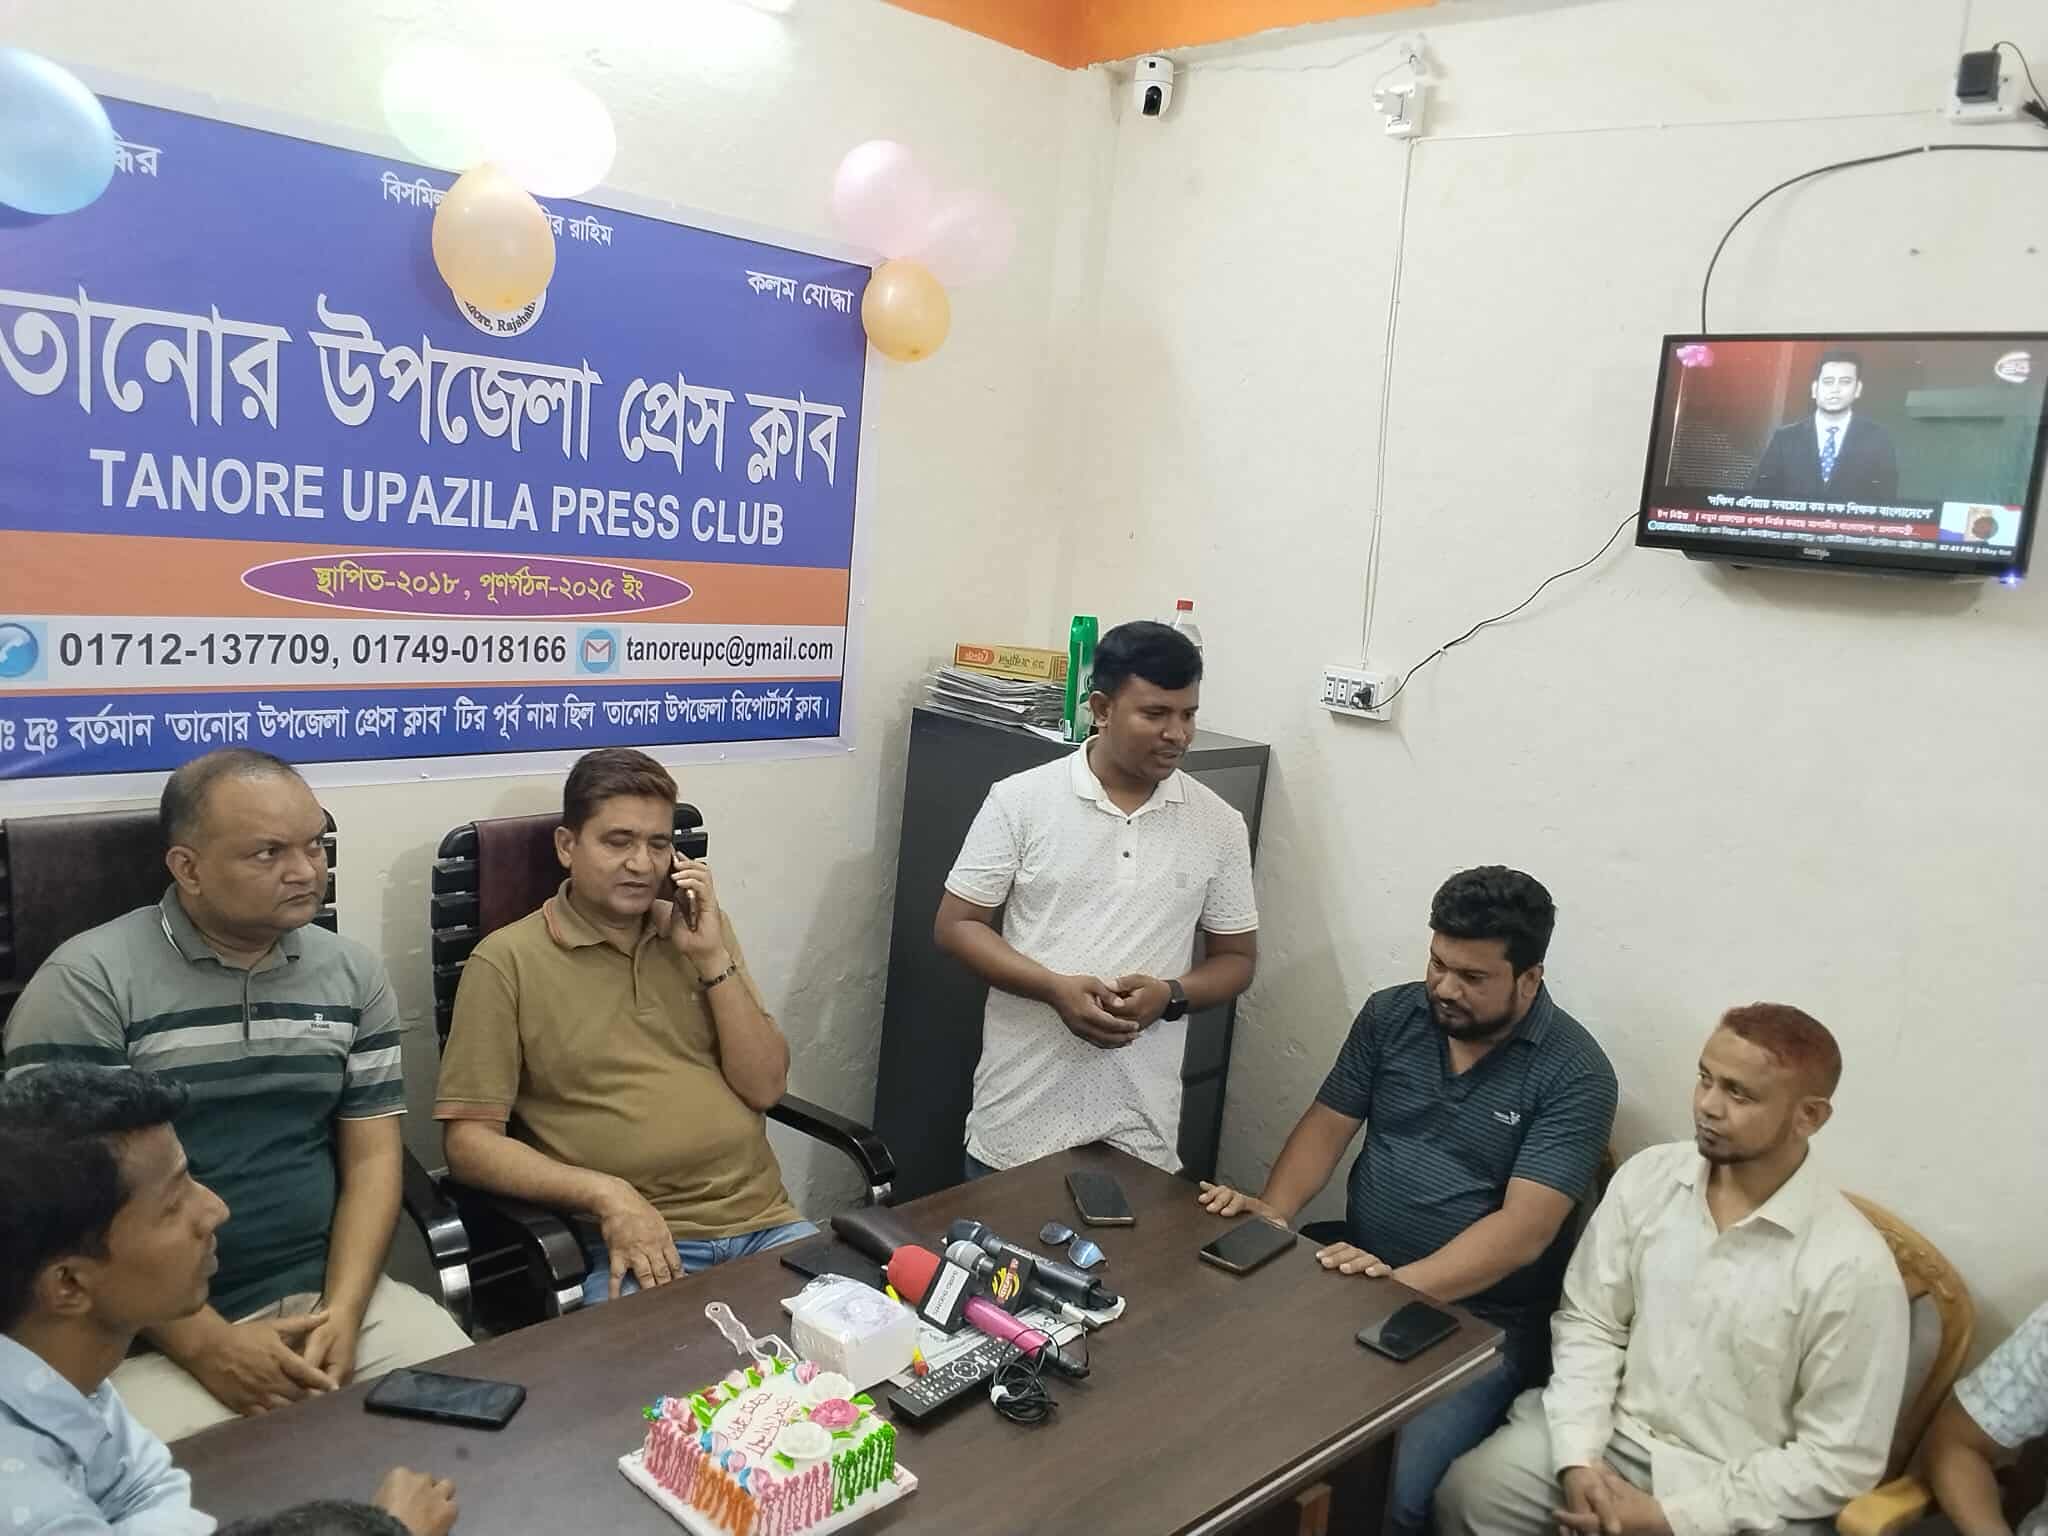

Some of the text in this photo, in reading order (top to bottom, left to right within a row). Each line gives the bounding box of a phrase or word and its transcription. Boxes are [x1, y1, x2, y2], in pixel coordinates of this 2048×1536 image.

[568, 215, 614, 248] রাহিম
[745, 270, 855, 313] কলম যোদ্ধা
[0, 284, 848, 488] তানোর উপজেলা প্রেস ক্লাব
[90, 448, 784, 546] TANORE UPAZILA PRESS CLUB
[622, 571, 646, 602] ইং
[59, 632, 834, 670] 01712-137709, 01749-018166 tanoreupc@gmail.com
[66, 703, 155, 750] বর্তমান
[257, 700, 350, 739] উপজেলা
[355, 705, 398, 738] প্রেস
[453, 696, 488, 732] টির
[493, 694, 524, 741] পূর্ব
[526, 701, 560, 730] নাম
[563, 693, 596, 730] ছিল
[664, 691, 728, 724] উপজেলা
[730, 688, 794, 722] রিপোর্টার্স
